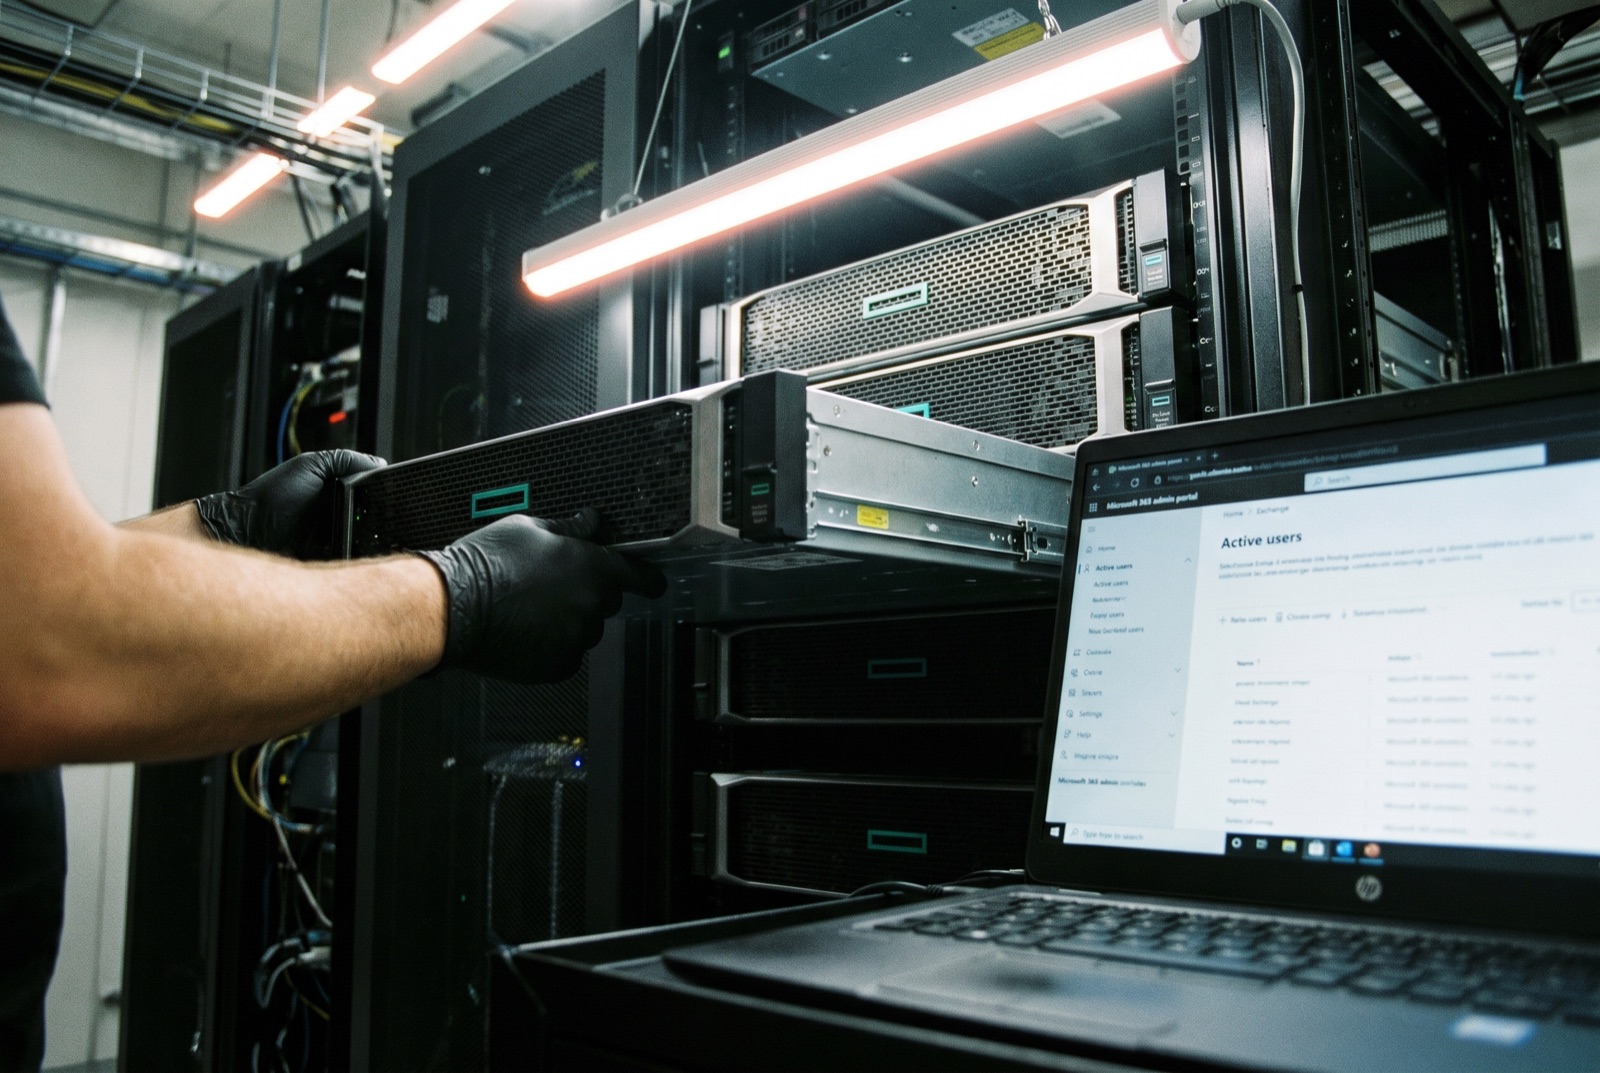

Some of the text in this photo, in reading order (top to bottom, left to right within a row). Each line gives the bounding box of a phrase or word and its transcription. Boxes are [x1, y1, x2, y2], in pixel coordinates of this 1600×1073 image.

[1107, 499, 1139, 510] Microsoft
[1153, 494, 1175, 504] admin
[1176, 492, 1199, 504] portal
[1256, 506, 1289, 515] Exchange
[1221, 533, 1302, 549] Active users
[1095, 564, 1115, 572] Active
[1058, 776, 1086, 785] Microsoft
